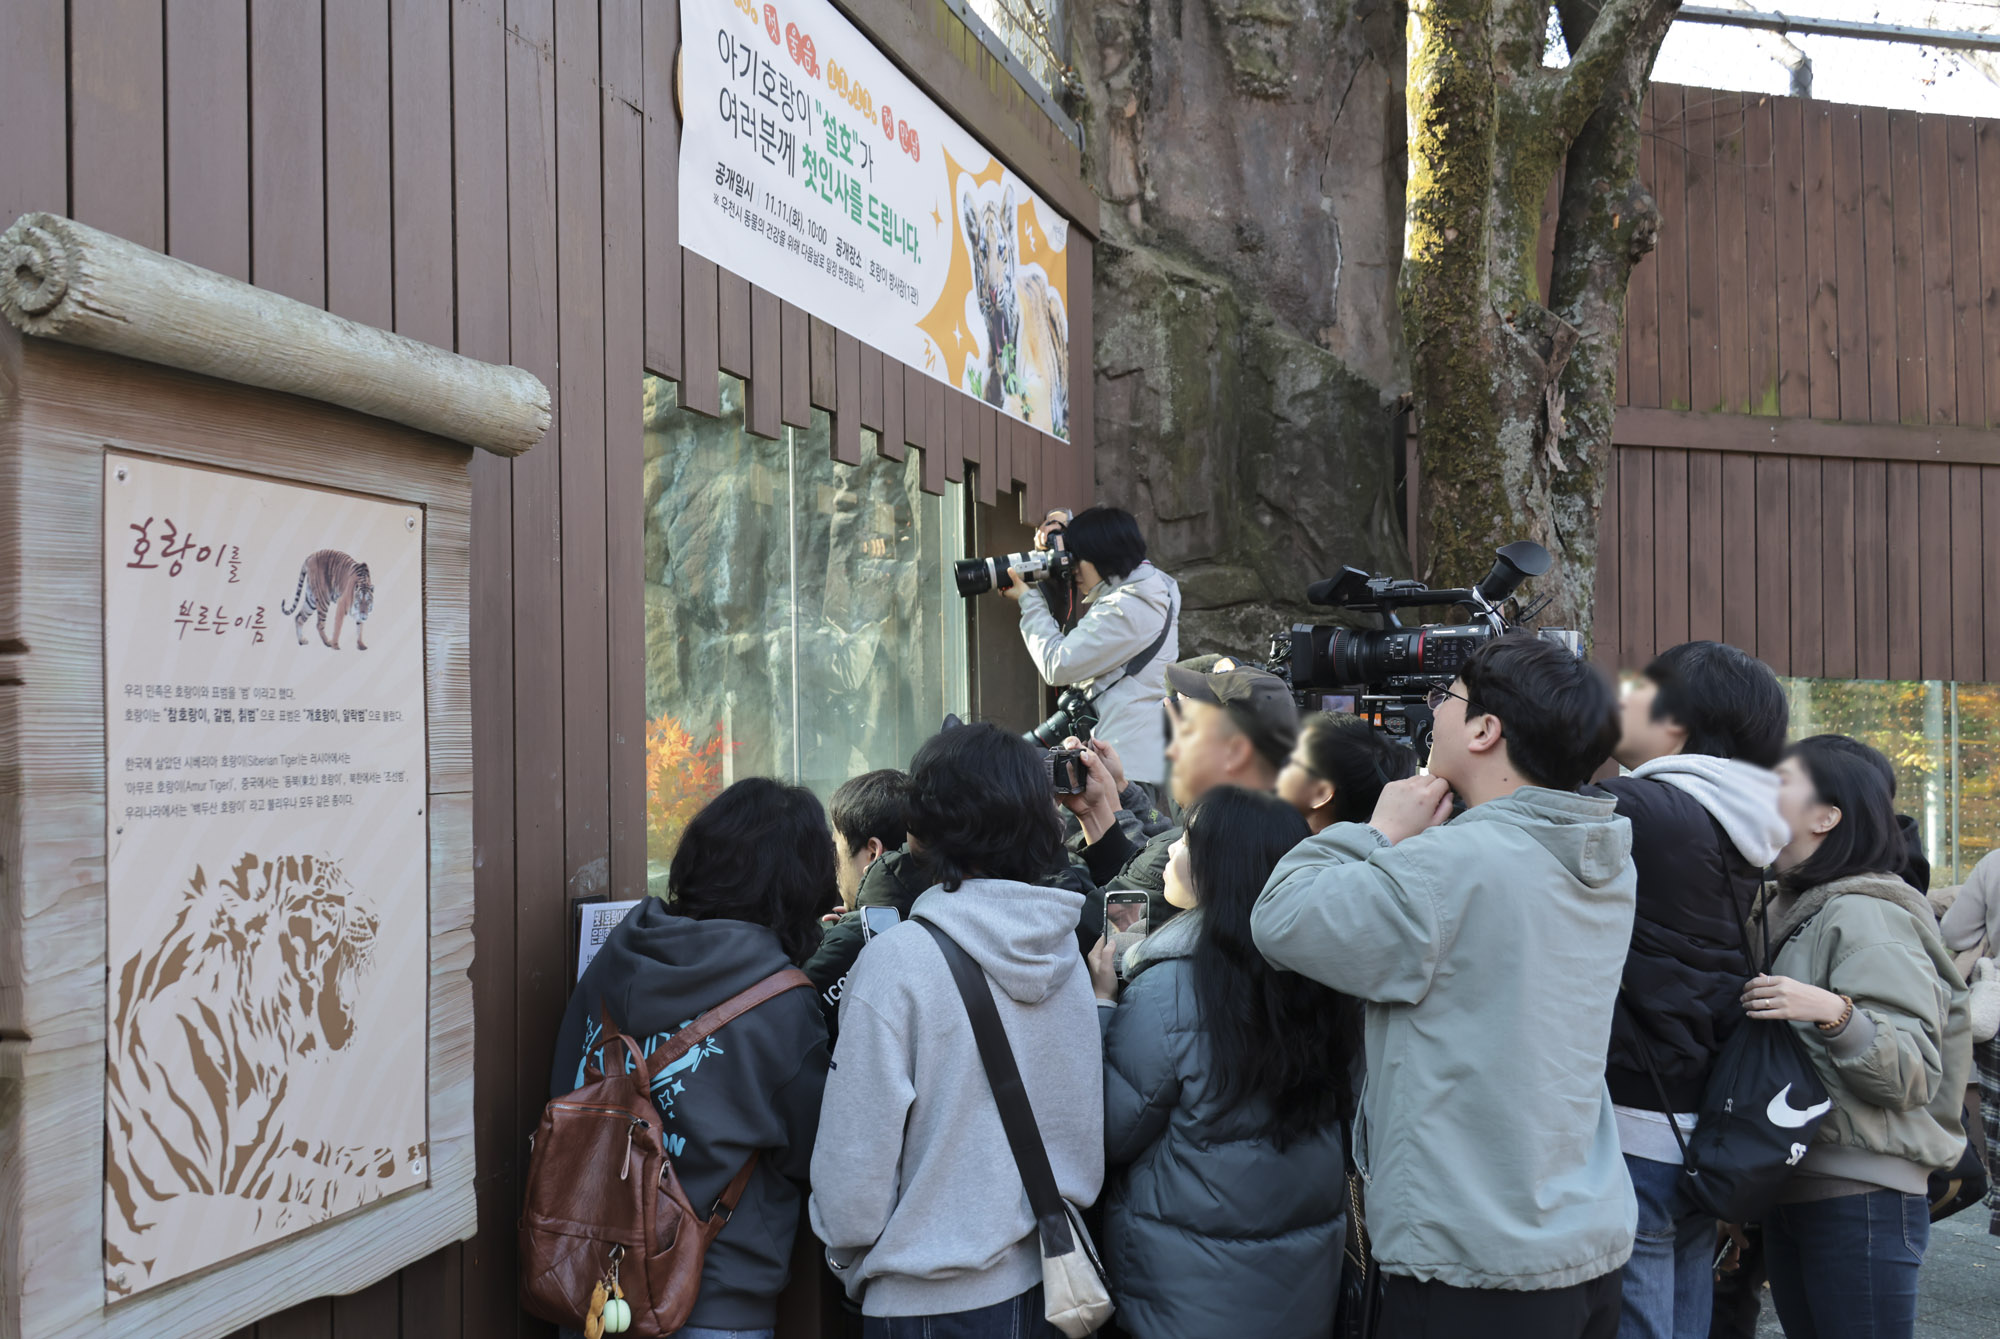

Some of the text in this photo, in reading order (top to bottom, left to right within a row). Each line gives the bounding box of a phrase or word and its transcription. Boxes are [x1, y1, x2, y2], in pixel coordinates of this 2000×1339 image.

[718, 29, 874, 184] 아기호랑이 "설호"가
[764, 4, 780, 45] 첫
[827, 58, 877, 125] 11.11.
[882, 105, 894, 141] 첫
[899, 119, 920, 163] 만남
[719, 87, 922, 265] 여러분께 첫인사를 드립니다.
[715, 161, 755, 203] 공개일시
[765, 192, 805, 236] 11.11.(화),
[807, 218, 828, 246] 10:00
[835, 236, 863, 269] 공개장소
[869, 260, 888, 287] 호랑이
[721, 196, 743, 223] 우천시
[744, 209, 765, 236] 동물의
[766, 222, 787, 248] 건강을
[787, 234, 801, 255] 위해
[801, 243, 825, 269] 다음날로
[826, 257, 838, 278] 일정
[126, 516, 243, 584] 호랑이를
[124, 684, 143, 698] 우리
[145, 684, 172, 699] 민족은
[175, 685, 209, 700] 호랑이와
[212, 686, 236, 700] 표범을
[125, 708, 161, 723] 호랑이는
[125, 757, 153, 772] 한국에
[184, 755, 218, 769] 시베리아
[241, 776, 279, 791] 중국에서는
[125, 803, 188, 820] 우리나라에서는
